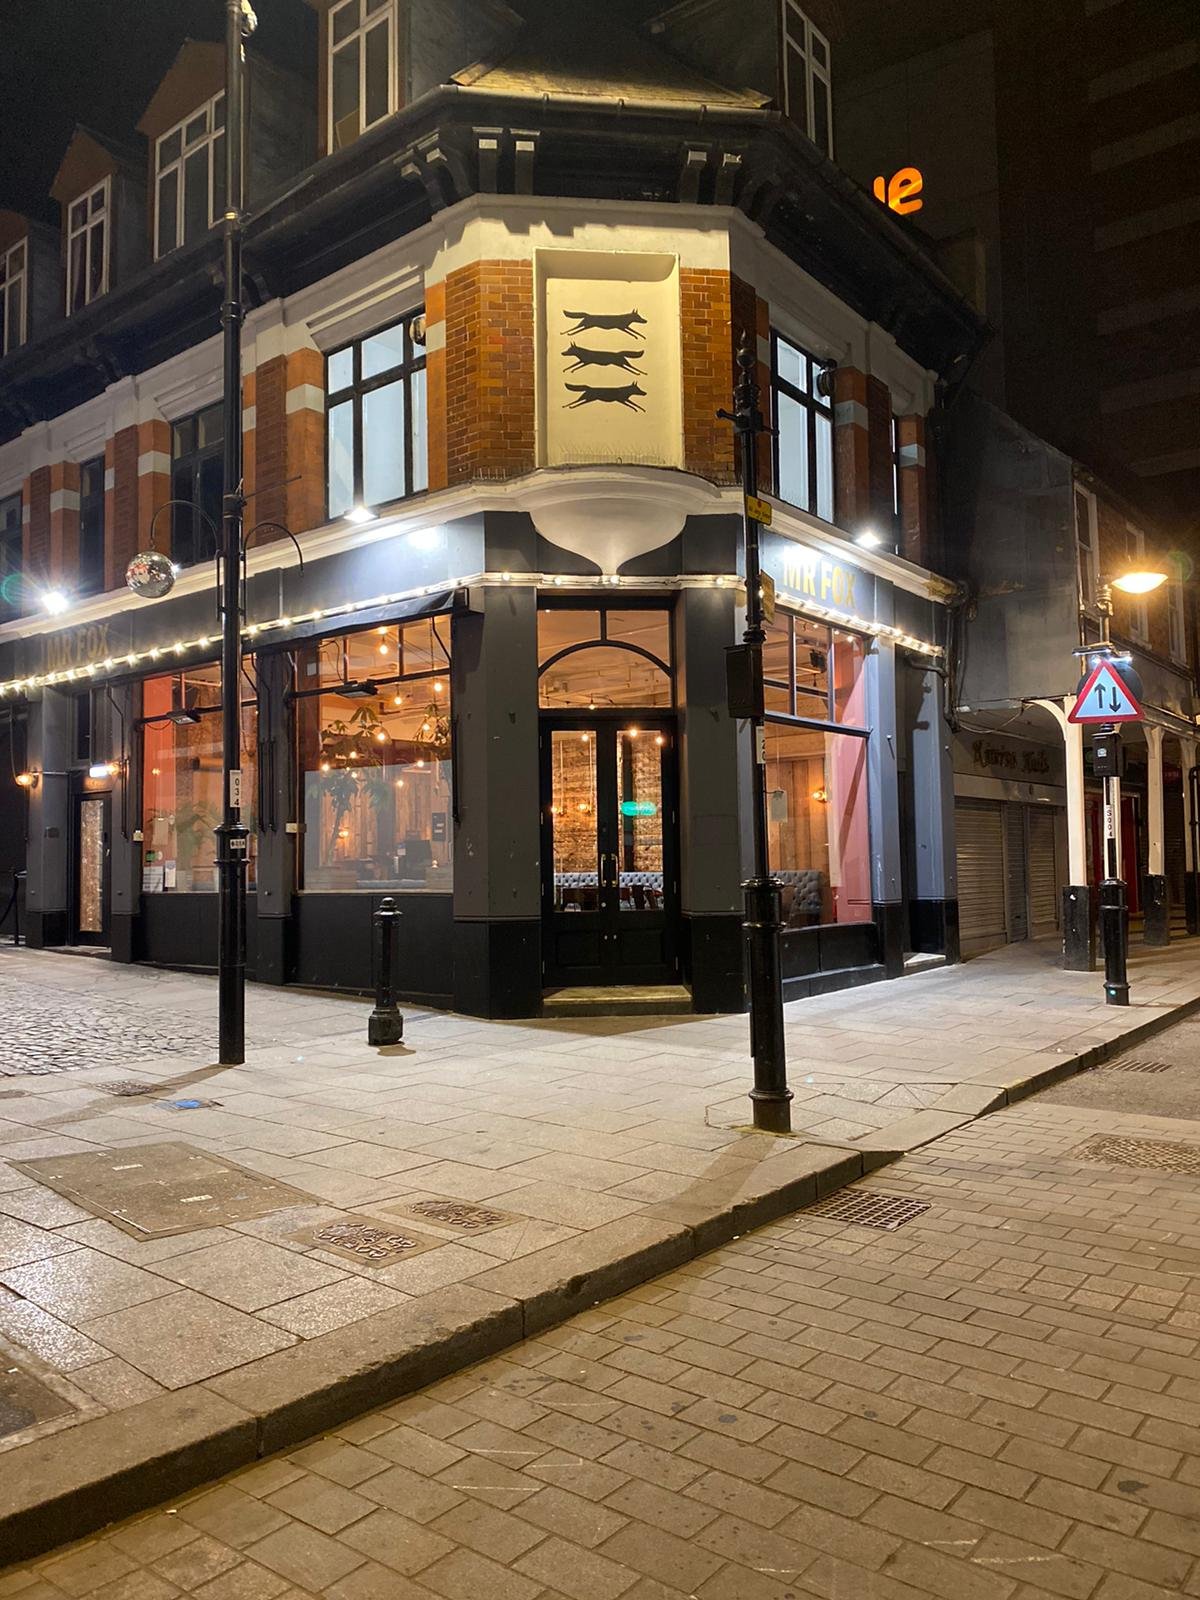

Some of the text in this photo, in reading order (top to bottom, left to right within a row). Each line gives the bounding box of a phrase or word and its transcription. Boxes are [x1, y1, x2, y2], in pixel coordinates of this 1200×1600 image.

[783, 546, 817, 598] MR
[820, 560, 857, 609] FOX
[47, 623, 109, 671] MR FOX
